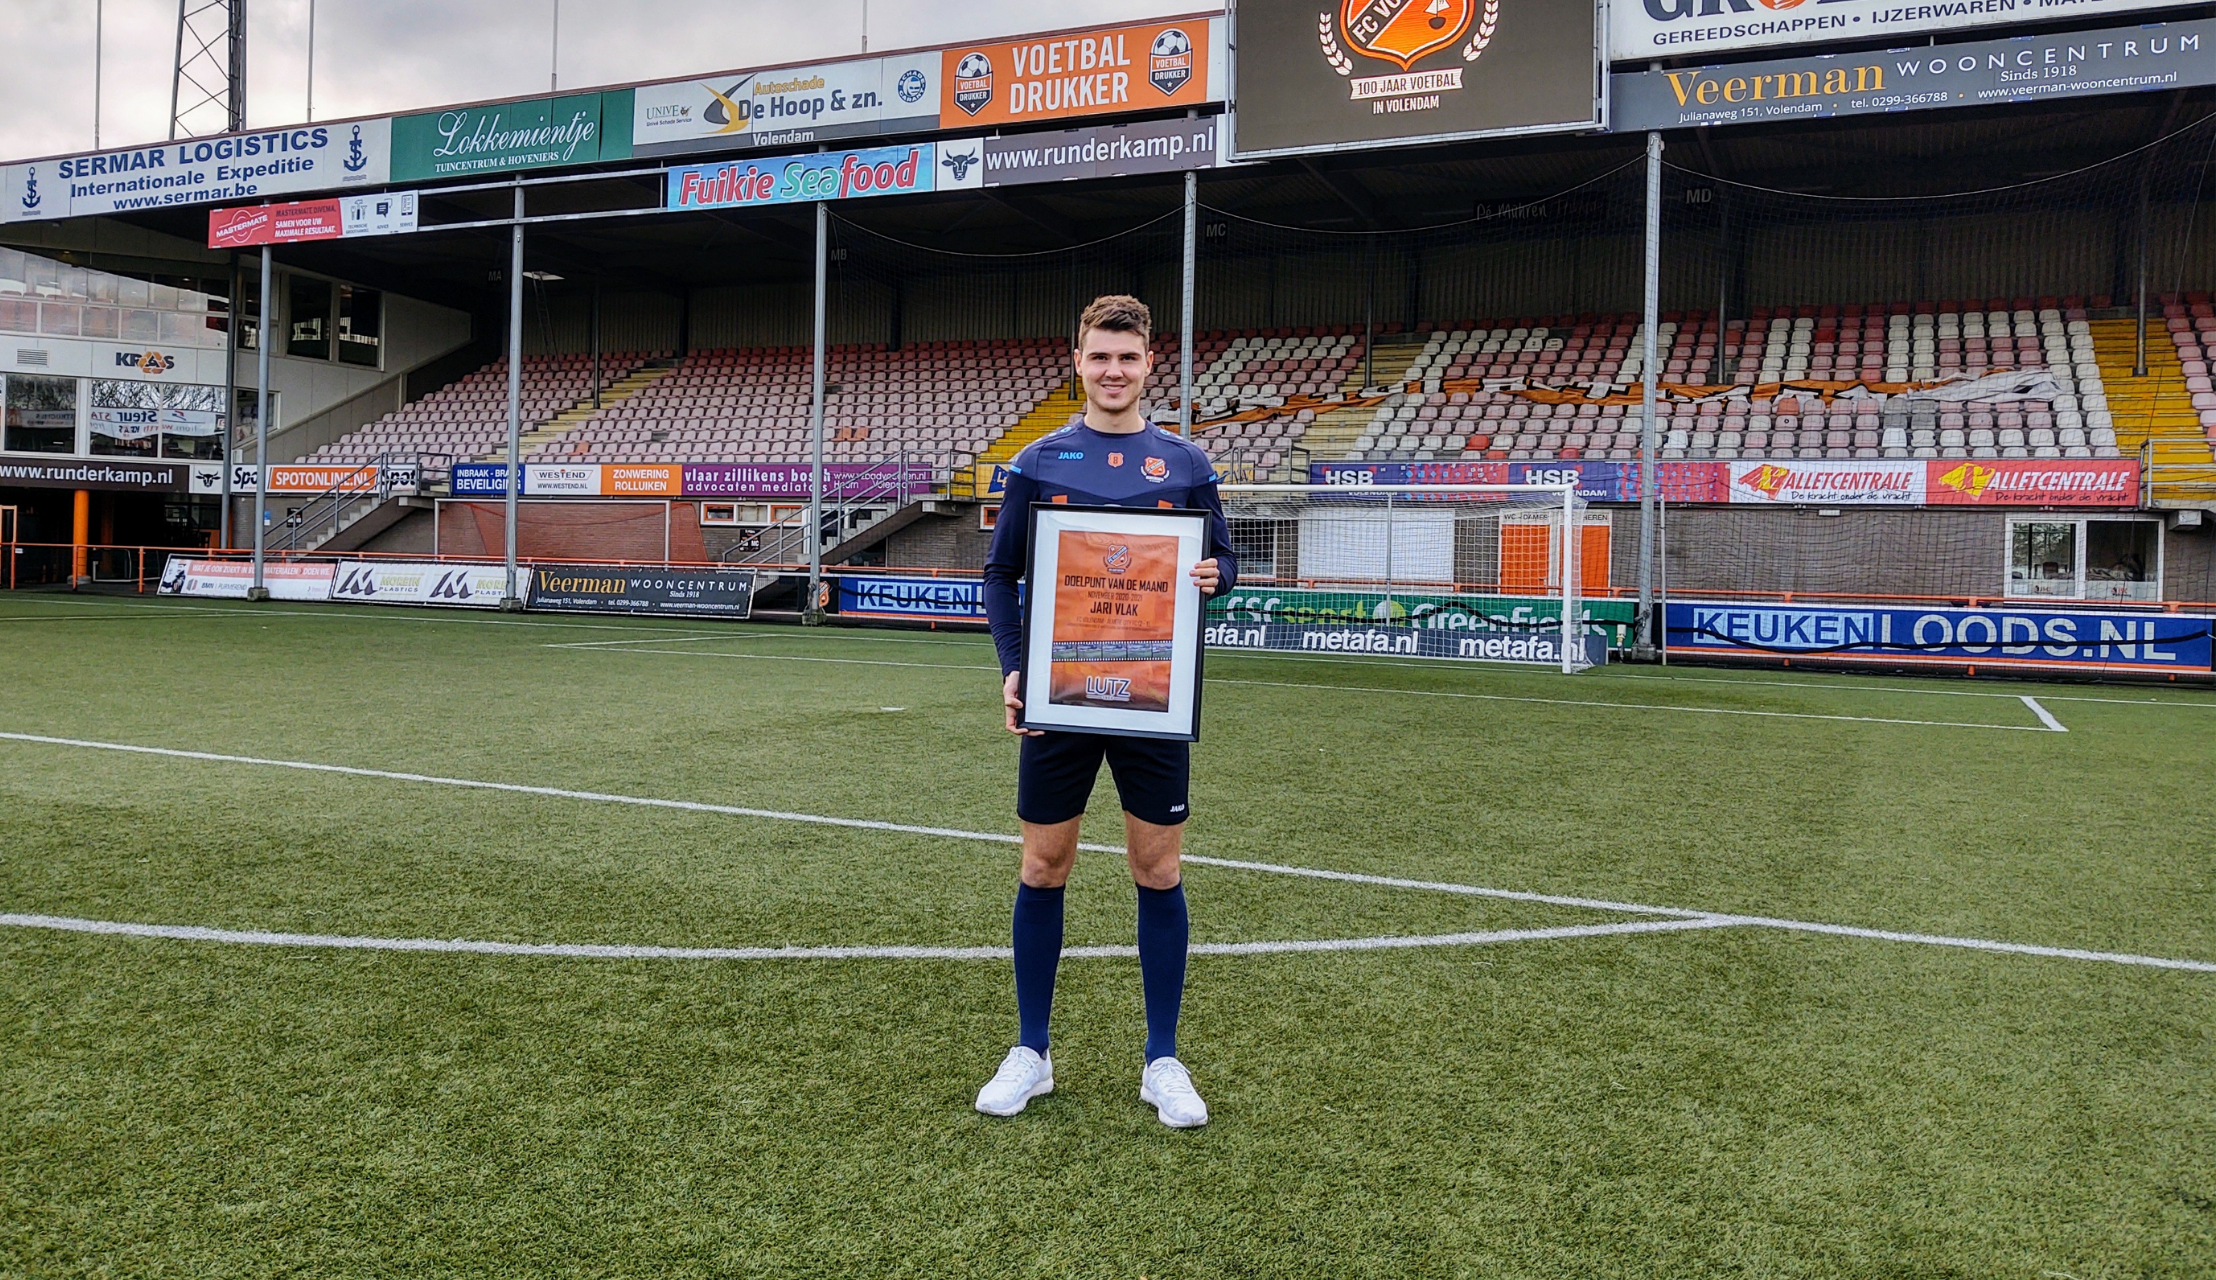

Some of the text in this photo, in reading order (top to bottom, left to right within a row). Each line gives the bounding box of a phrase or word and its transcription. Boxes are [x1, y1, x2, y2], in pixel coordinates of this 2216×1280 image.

[1352, 15, 1379, 43] FC
[1653, 14, 1846, 46] GEREEDSCHAPPEN
[1872, 0, 2015, 24] IJZERWAREN
[1012, 34, 1131, 77] VOETBAL
[1155, 57, 1186, 68] VOETBAL
[1154, 69, 1186, 80] DRUKKER
[1663, 34, 2200, 107] Veerman WOONCENTRUM
[2000, 65, 2077, 82] Sinds 1918
[753, 75, 825, 96] Autoschade
[960, 78, 987, 90] VOETBAL
[1009, 71, 1129, 114] DRUKKER
[1358, 73, 1455, 96] 100 JAAR VOETBAL
[959, 90, 987, 102] DRUKKER
[1679, 71, 2177, 123] Julianaweg 151, Volendam tel. 0299-366788 www.veerman-wooncentrum.nl
[738, 89, 883, 121] De Hoop & zn.
[1373, 95, 1440, 115] IN VOLENDAM
[433, 110, 595, 162] Lokkemientje
[752, 129, 814, 146] Volendam
[58, 128, 329, 180] SERMAR LOGISTICS
[985, 126, 1214, 170] www.runderkamp.nl
[435, 151, 559, 173] TUINCENTRUM & HOVENIERS
[71, 157, 314, 198] Internationale Expeditie
[679, 149, 920, 206] Fuikie Seafood
[113, 183, 257, 211] www.sermar.be
[1686, 188, 1712, 204] MD
[276, 207, 313, 217] MASTERMATE
[216, 214, 268, 238] MASTERMATE
[275, 217, 322, 228] SAMEN VOOR UW
[1206, 222, 1226, 238] MC
[275, 226, 336, 237] MAXIMALE RESULTAAT.
[115, 352, 175, 370] KRAS
[1058, 451, 1084, 460] JAKO
[0, 465, 173, 486] www.runderkamp.nl
[233, 467, 257, 490] Spo
[275, 471, 370, 487] SPOTONLINE.NL
[457, 469, 522, 478] INBRAAK BRAD
[539, 470, 586, 479] WESTEND
[612, 469, 670, 480] ZONWERING
[684, 468, 831, 482] vlaar zillikens bosh
[1325, 470, 1374, 485] HSB
[1526, 469, 1579, 485] HSB
[456, 479, 522, 490] BEVEILIGIG
[537, 482, 588, 490] WWW.WESTEND.NL
[614, 481, 667, 491] ROLLUIKEN
[687, 481, 828, 492] advocaten mediatos
[1792, 490, 1912, 501] De kracht onder de vracht
[538, 570, 748, 594] Veerman WOONCENTRUM
[1064, 574, 1168, 593] DOELPUNT VAN DE MAAND
[572, 598, 597, 606] Volendam
[669, 590, 685, 598] Sinds
[1087, 590, 1115, 600] NOVEMBER
[1090, 601, 1138, 616] JARI VLAK
[1204, 622, 1266, 647] afa.nl
[1302, 629, 1419, 654] metafa.nl
[1086, 677, 1130, 696] LUTZ
